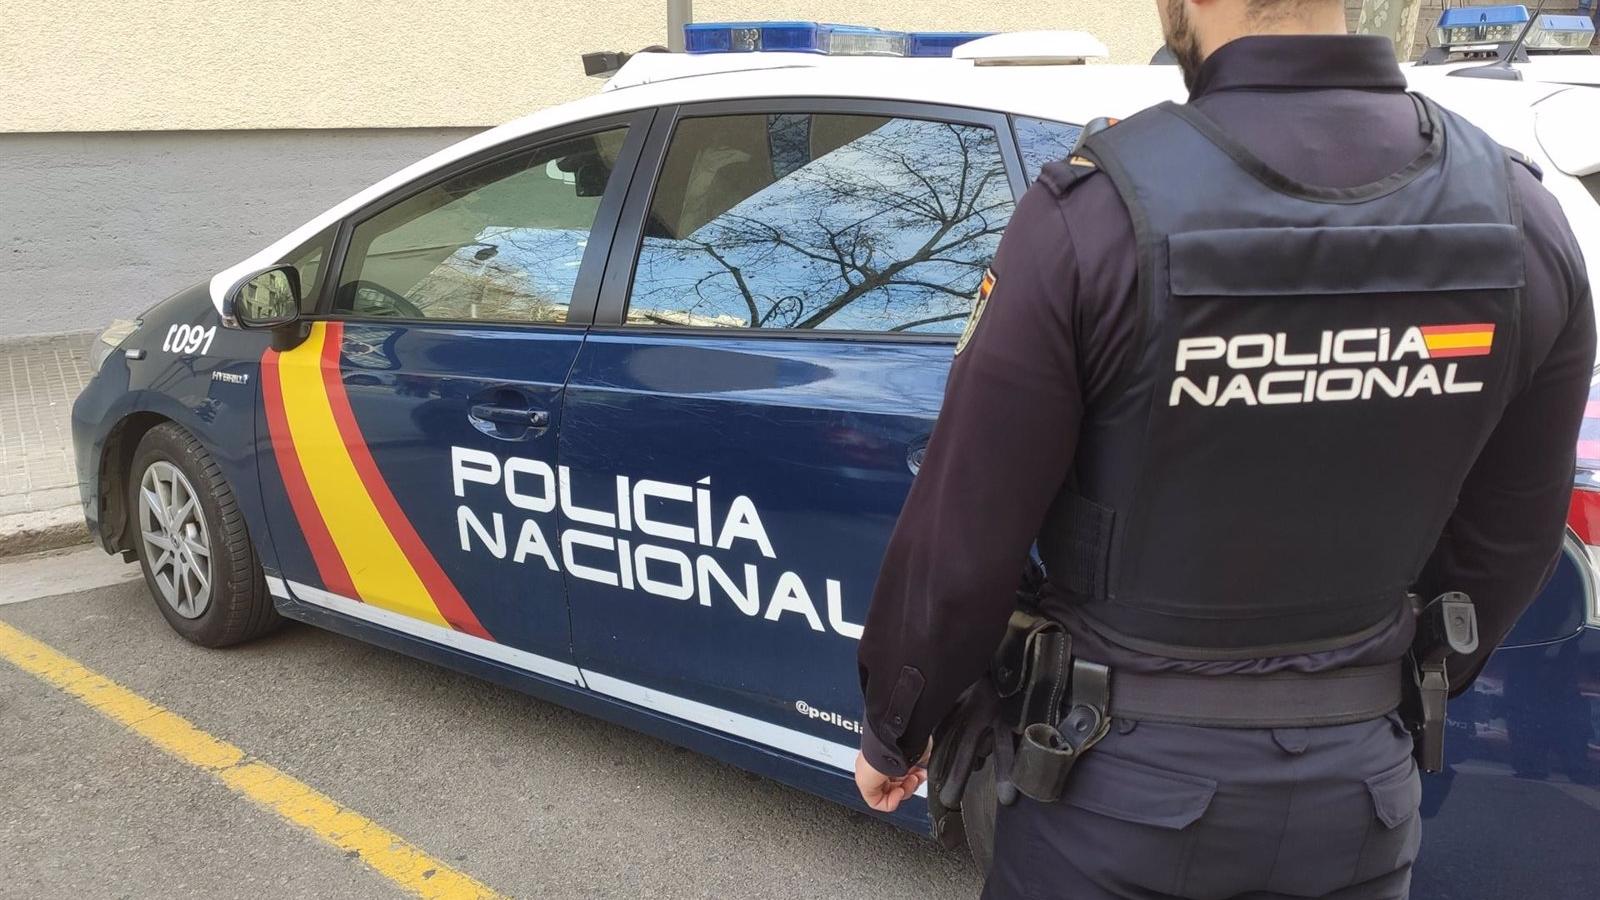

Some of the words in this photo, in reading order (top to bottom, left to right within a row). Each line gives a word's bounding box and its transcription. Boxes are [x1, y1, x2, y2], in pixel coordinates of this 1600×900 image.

[1168, 363, 1484, 407] NACIONAL
[451, 446, 777, 559] POLICÍA
[456, 505, 866, 641] NACIONAL
